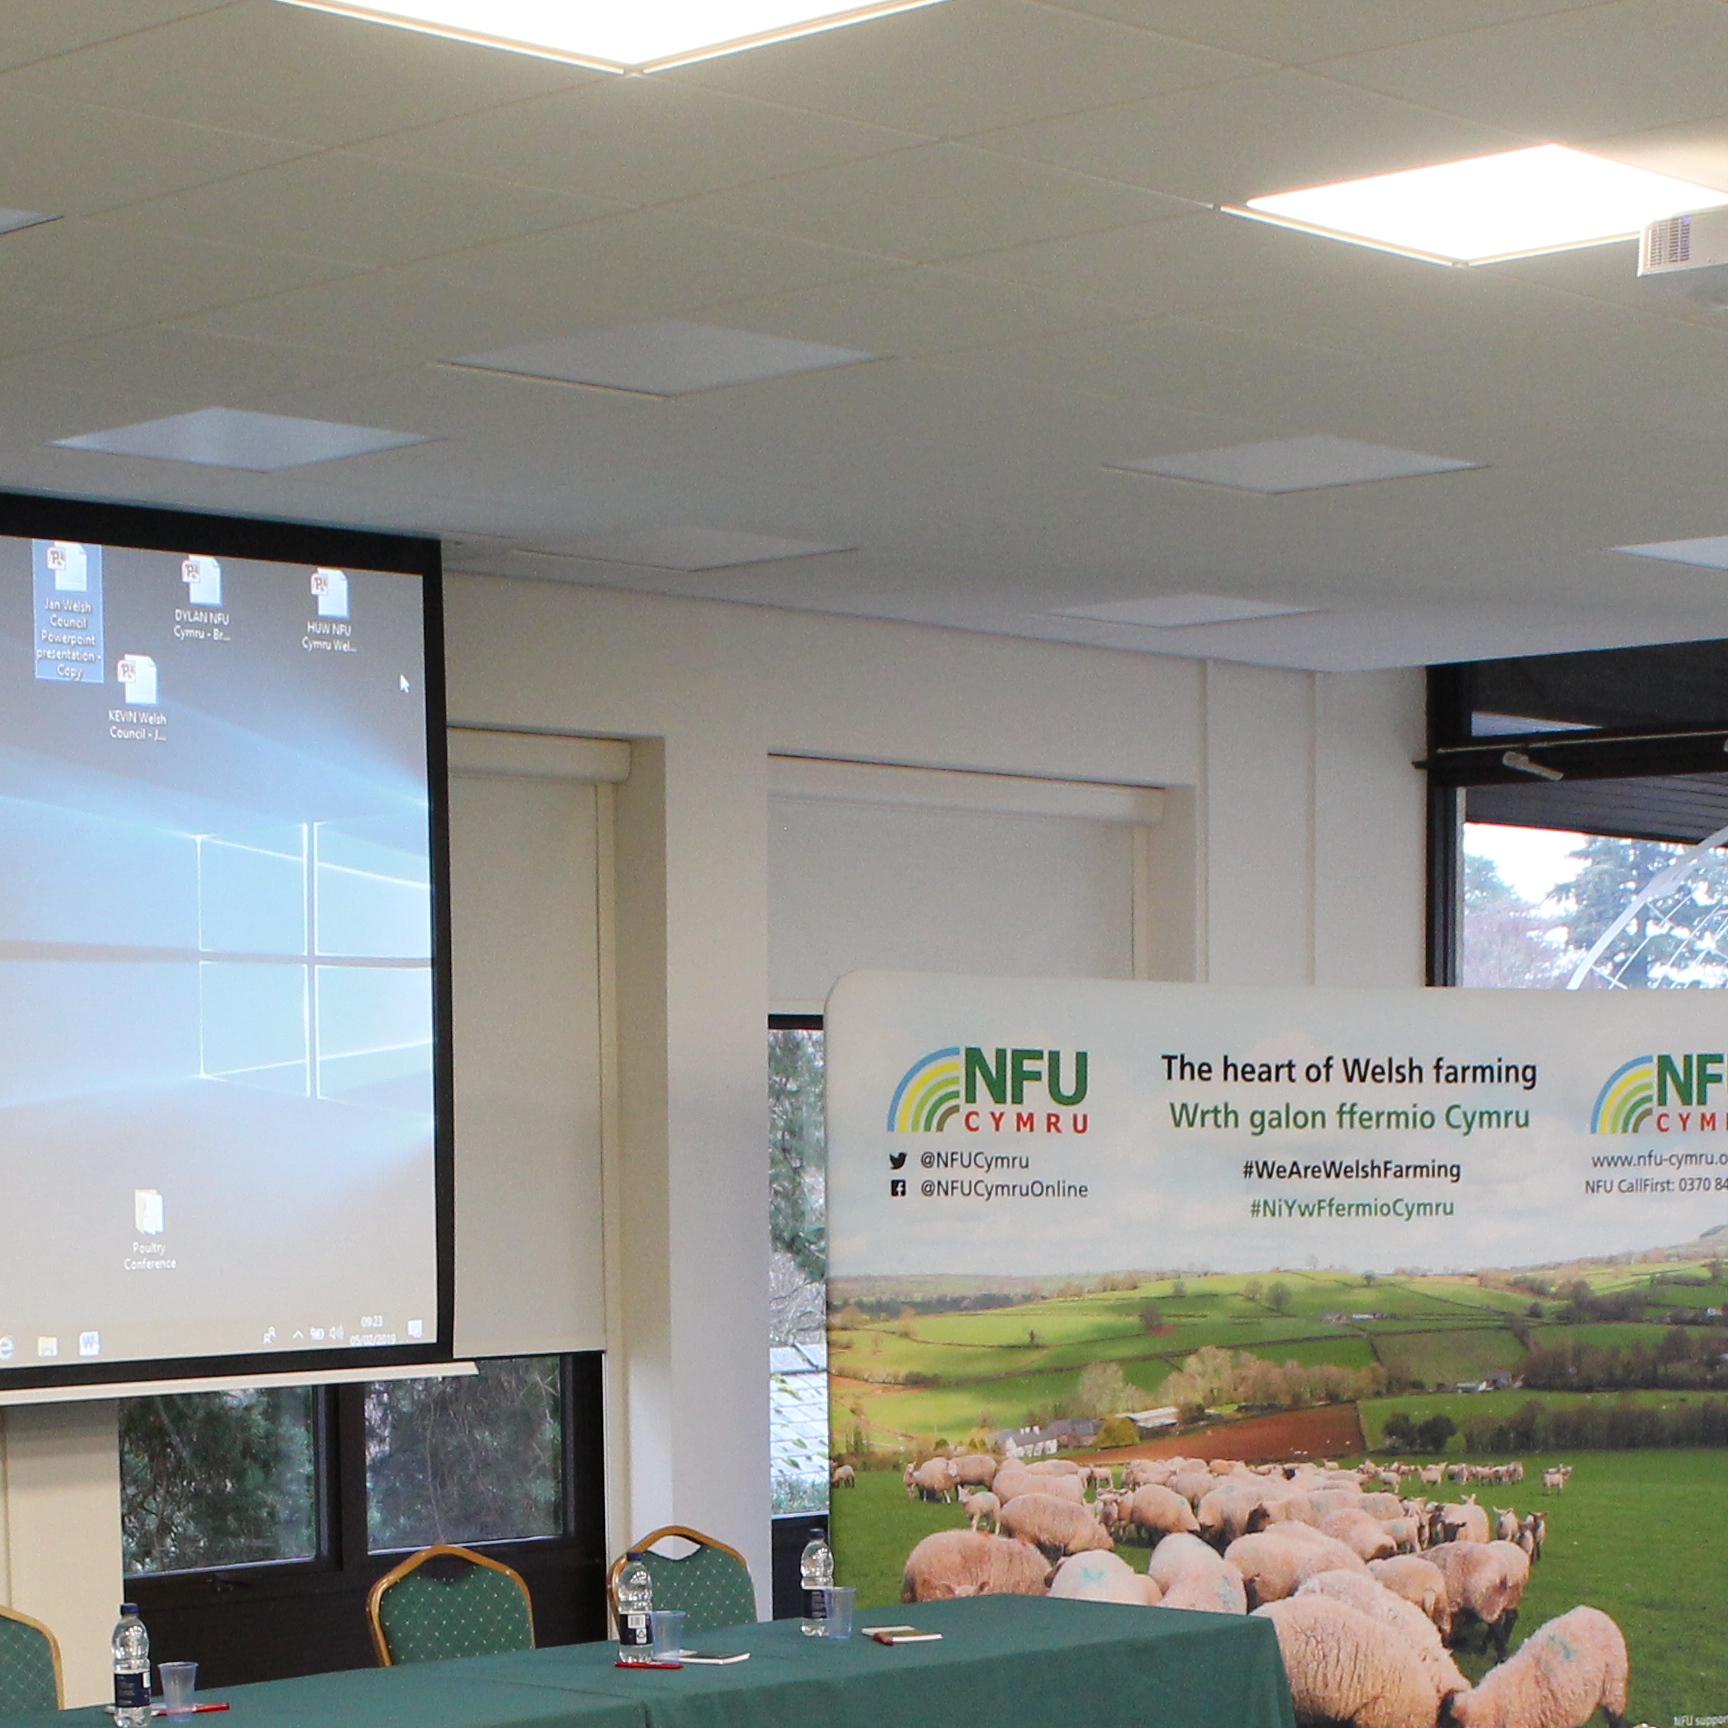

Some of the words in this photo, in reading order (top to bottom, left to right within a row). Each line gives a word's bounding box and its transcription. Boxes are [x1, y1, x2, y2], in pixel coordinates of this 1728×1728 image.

[63, 599, 92, 613] Welsh
[50, 614, 87, 628] Council
[175, 609, 208, 624] DYLAN
[209, 610, 230, 626] NFU
[41, 629, 96, 647] Powerpoint
[174, 625, 205, 641] Cymru
[301, 636, 331, 652] Cymru
[37, 648, 95, 662] presentation
[57, 664, 83, 680] Copy
[109, 709, 138, 724] KEVIN
[139, 711, 167, 725] Welsh
[109, 725, 146, 740] Council
[964, 1046, 1089, 1106] NFU
[1162, 1054, 1213, 1083] The
[1223, 1055, 1296, 1083] heart
[1305, 1056, 1334, 1083] of
[1342, 1057, 1423, 1084] Welsh
[1434, 1057, 1537, 1090] farming
[964, 1110, 1089, 1134] CYMRU
[1170, 1102, 1239, 1129] Wrth
[1250, 1102, 1326, 1136] galon
[1336, 1102, 1436, 1130] ffermio
[1445, 1104, 1530, 1136] Cymru
[921, 1151, 1029, 1174] @NFUCymru
[1243, 1159, 1461, 1183] #WeAreWelshFarming
[921, 1179, 1088, 1202] @NFUCymruOnline
[1585, 1180, 1614, 1194] NFU
[1618, 1178, 1675, 1194] CallFirst:
[1679, 1177, 1712, 1193] 0370
[1250, 1198, 1454, 1222] #NiYwFfermioCymru
